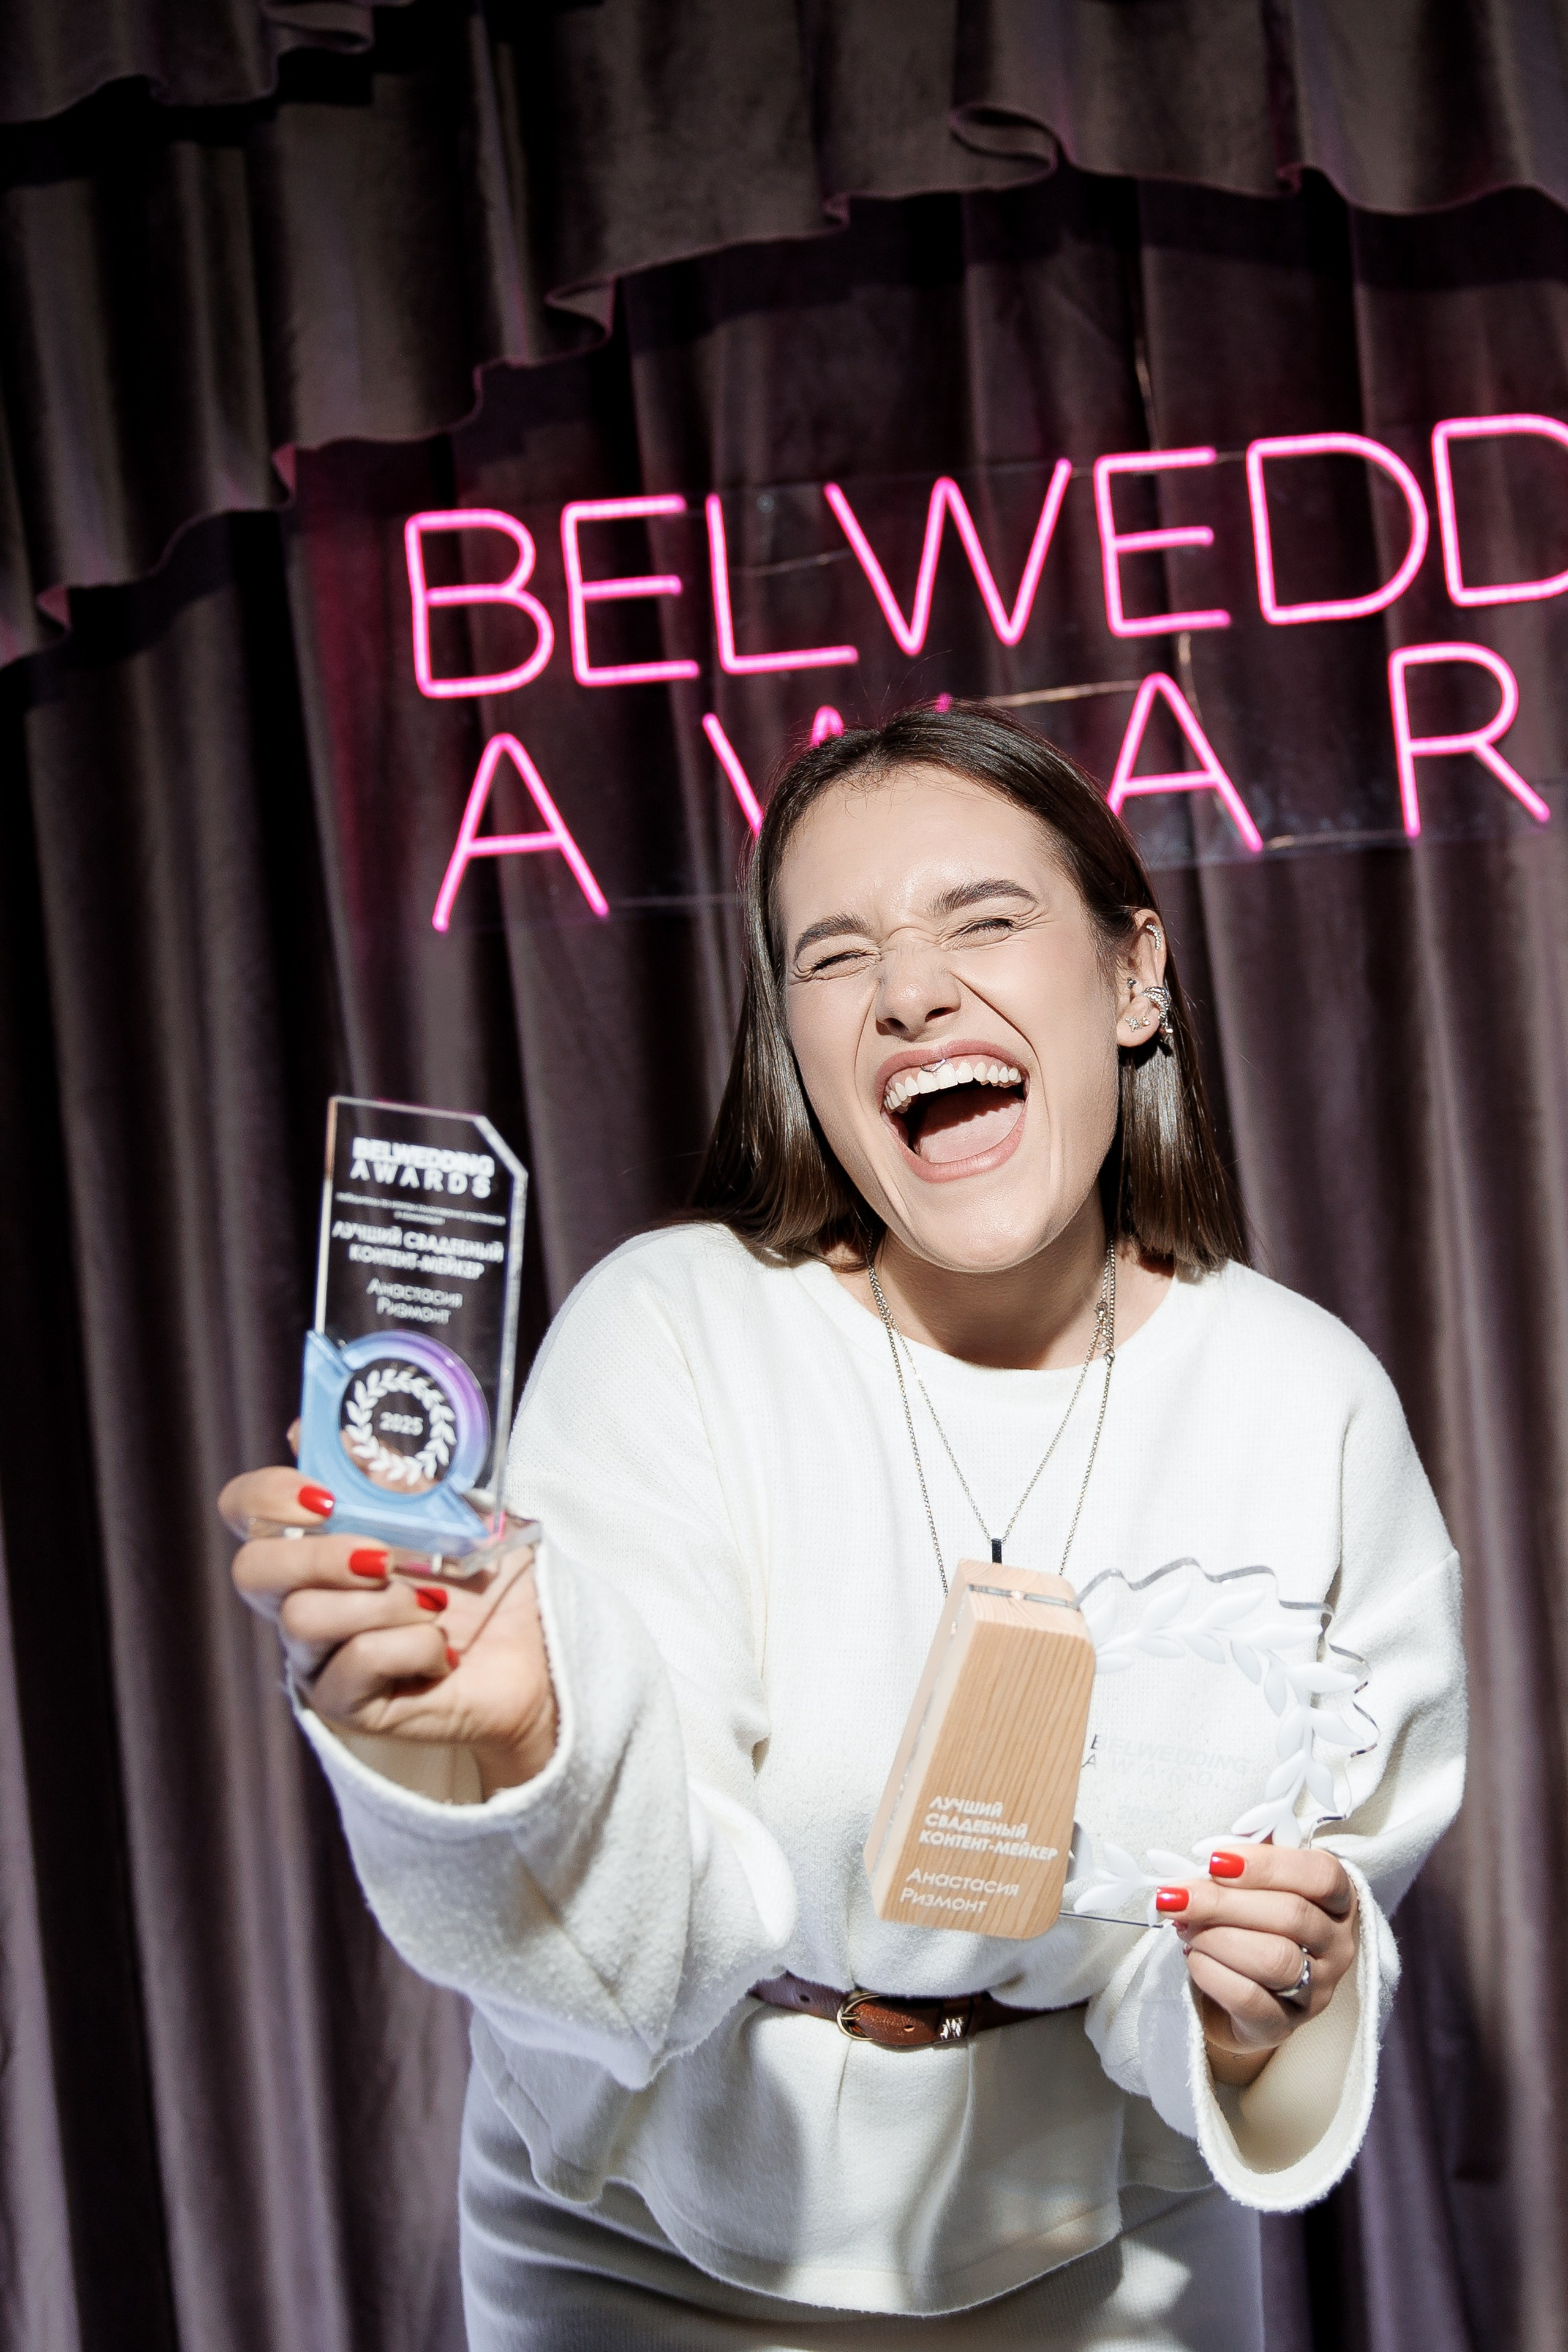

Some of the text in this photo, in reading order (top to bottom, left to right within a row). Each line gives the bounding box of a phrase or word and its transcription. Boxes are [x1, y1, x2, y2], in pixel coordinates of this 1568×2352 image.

[404, 414, 1568, 699] BELWEDD
[431, 641, 1551, 933] AAR
[349, 1159, 491, 1199] AWARDS
[331, 1220, 505, 1263] ЛУЧШИЙ СВАДЕБНЫЙ
[379, 1411, 424, 1436] 2025
[1090, 1733, 1251, 1776] BELWEDDING
[1081, 1753, 1238, 1795] AWARD
[929, 1795, 1003, 1818] ЛУЧШИЙ
[924, 1812, 1029, 1840] СВАДЕБНЫЙ
[919, 1829, 1059, 1861] КОНТЕНТ-МЕЙКЕР
[899, 1887, 988, 1913] Ризмонт
[905, 1868, 1020, 1898] Анастасия
